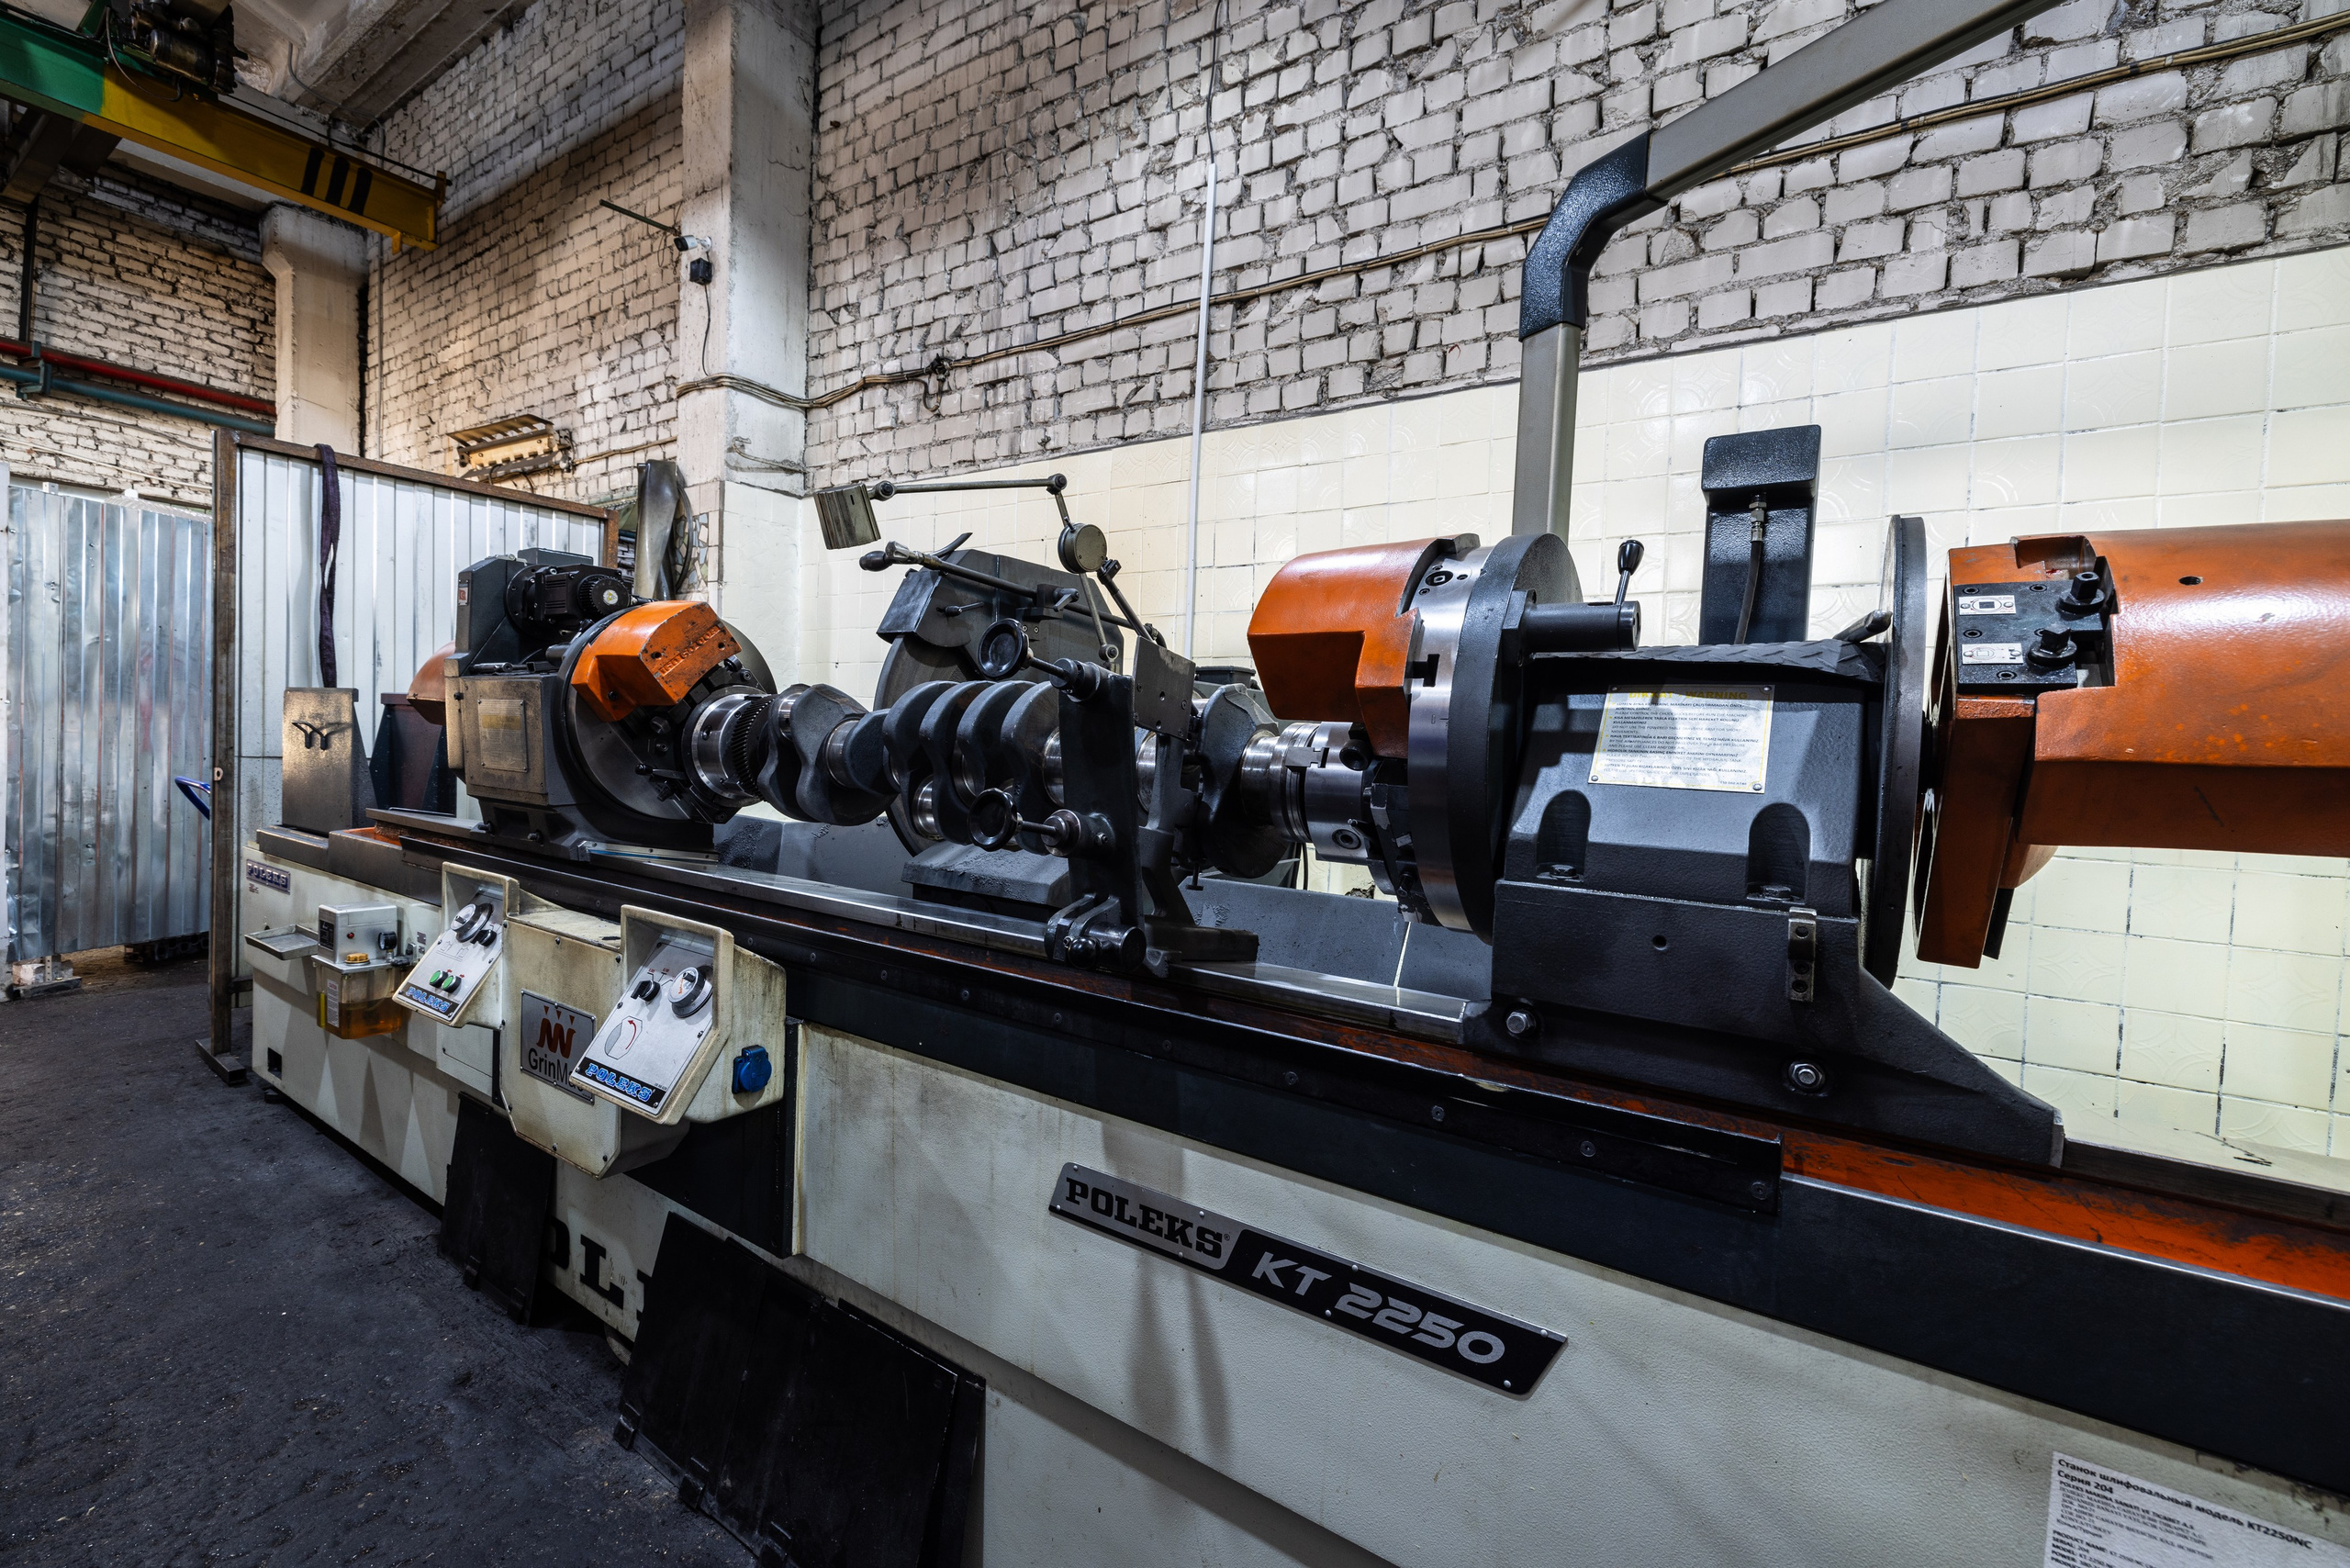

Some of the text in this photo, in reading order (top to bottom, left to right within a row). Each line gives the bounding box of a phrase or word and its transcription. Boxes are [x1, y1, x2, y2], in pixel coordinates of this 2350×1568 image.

[247, 862, 287, 889] POLEKS
[406, 987, 451, 1013] POLEKS
[586, 1062, 652, 1102] POLEKS
[1066, 1176, 1506, 1365] POLEKS KT 2250
[2058, 1470, 2113, 1494] Серия 204
[2060, 1480, 2084, 1492] POLEKS
[2059, 1461, 2312, 1550] Станок шлифовальный модель KT2250NC
[2053, 1530, 2084, 1545] PRODUCT
